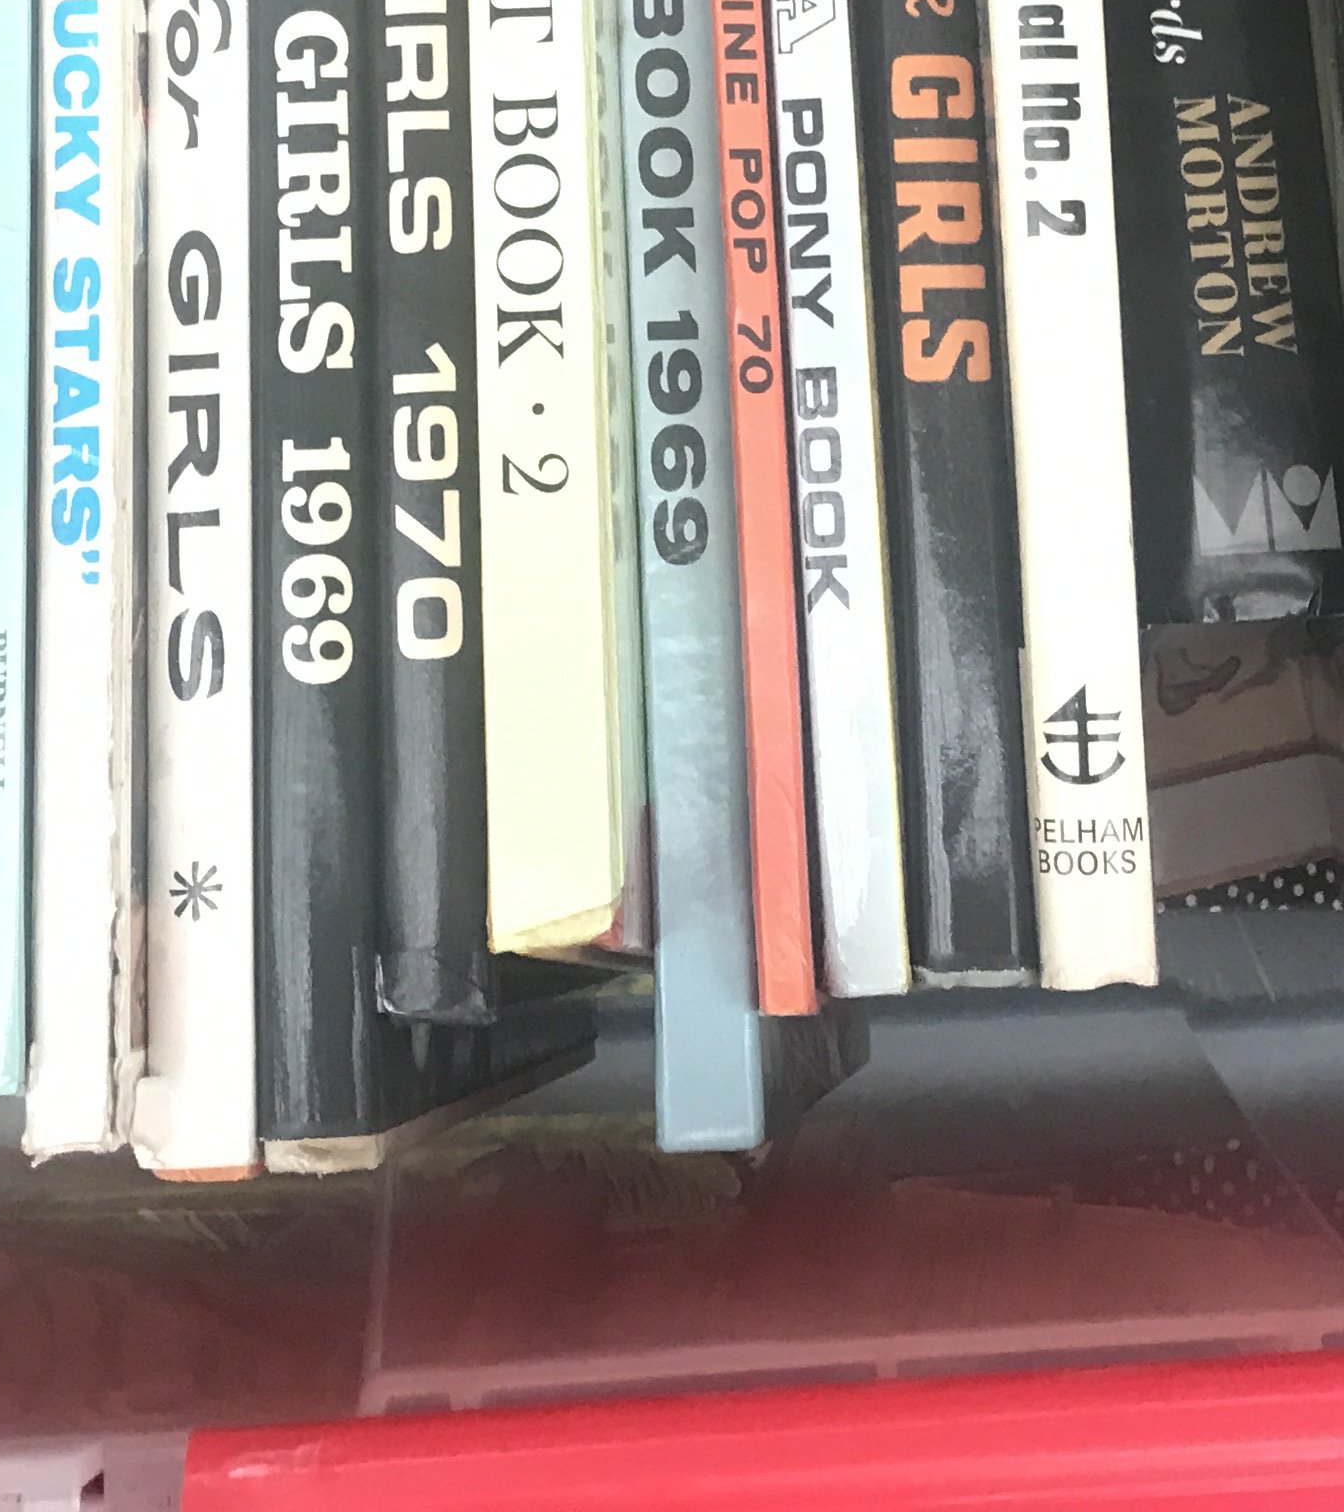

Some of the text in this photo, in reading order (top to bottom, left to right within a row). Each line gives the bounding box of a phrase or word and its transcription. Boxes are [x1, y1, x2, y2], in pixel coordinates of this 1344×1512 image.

[274, 10, 355, 374] GIRLS
[492, 89, 565, 369] BOOK
[728, 146, 767, 275] POP
[780, 96, 835, 330] PONY
[890, 53, 992, 385] GIRLS
[1026, 199, 1087, 238] 2
[1173, 95, 1244, 357] MORTON
[1227, 92, 1297, 355] ANDREW
[167, 230, 225, 702] GIRLS
[502, 453, 569, 496] 2
[646, 310, 709, 566] 1969
[735, 312, 775, 395] 70
[280, 437, 354, 685] 1969
[391, 342, 463, 660] 1970
[795, 365, 851, 616] BOOK
[1035, 816, 1144, 845] PELHAM
[1039, 848, 1137, 876] BOOKS
